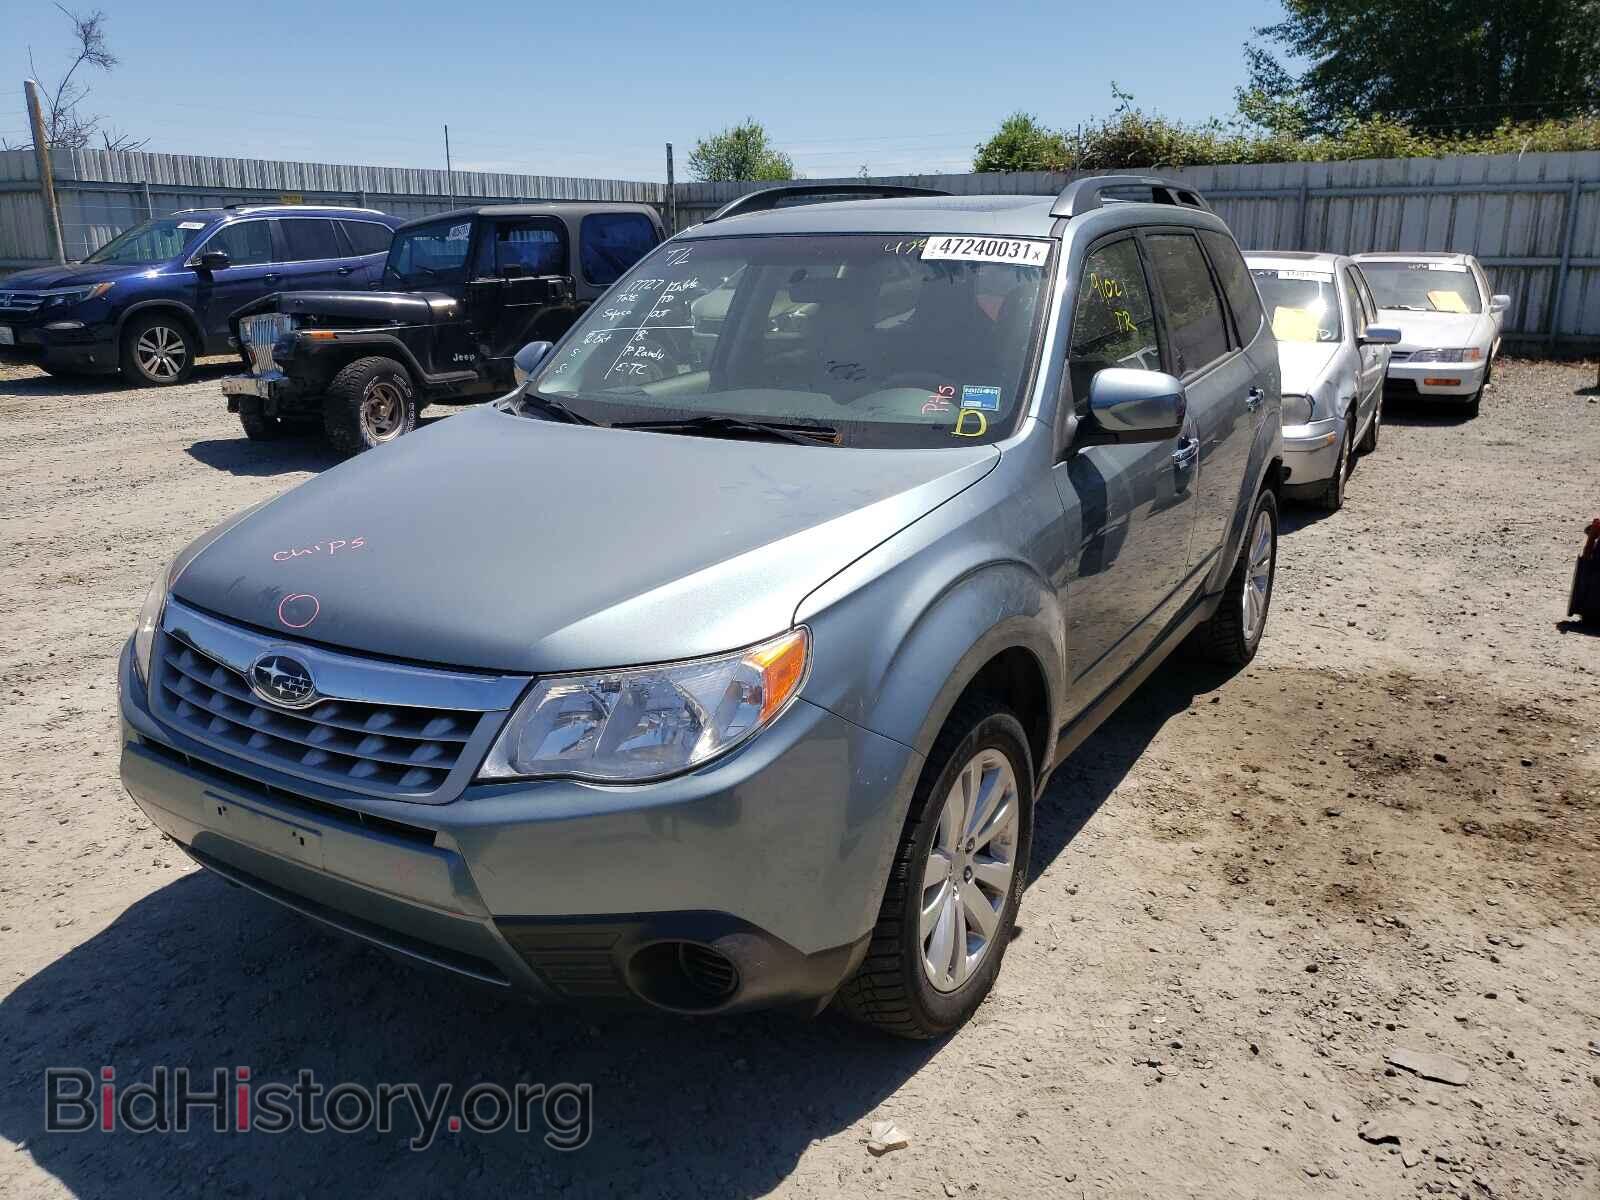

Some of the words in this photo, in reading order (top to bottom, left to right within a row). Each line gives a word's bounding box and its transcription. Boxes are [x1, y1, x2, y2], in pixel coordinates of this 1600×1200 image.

[938, 238, 1031, 259] 47240031
[452, 352, 476, 362] Jeep
[951, 408, 987, 437] D
